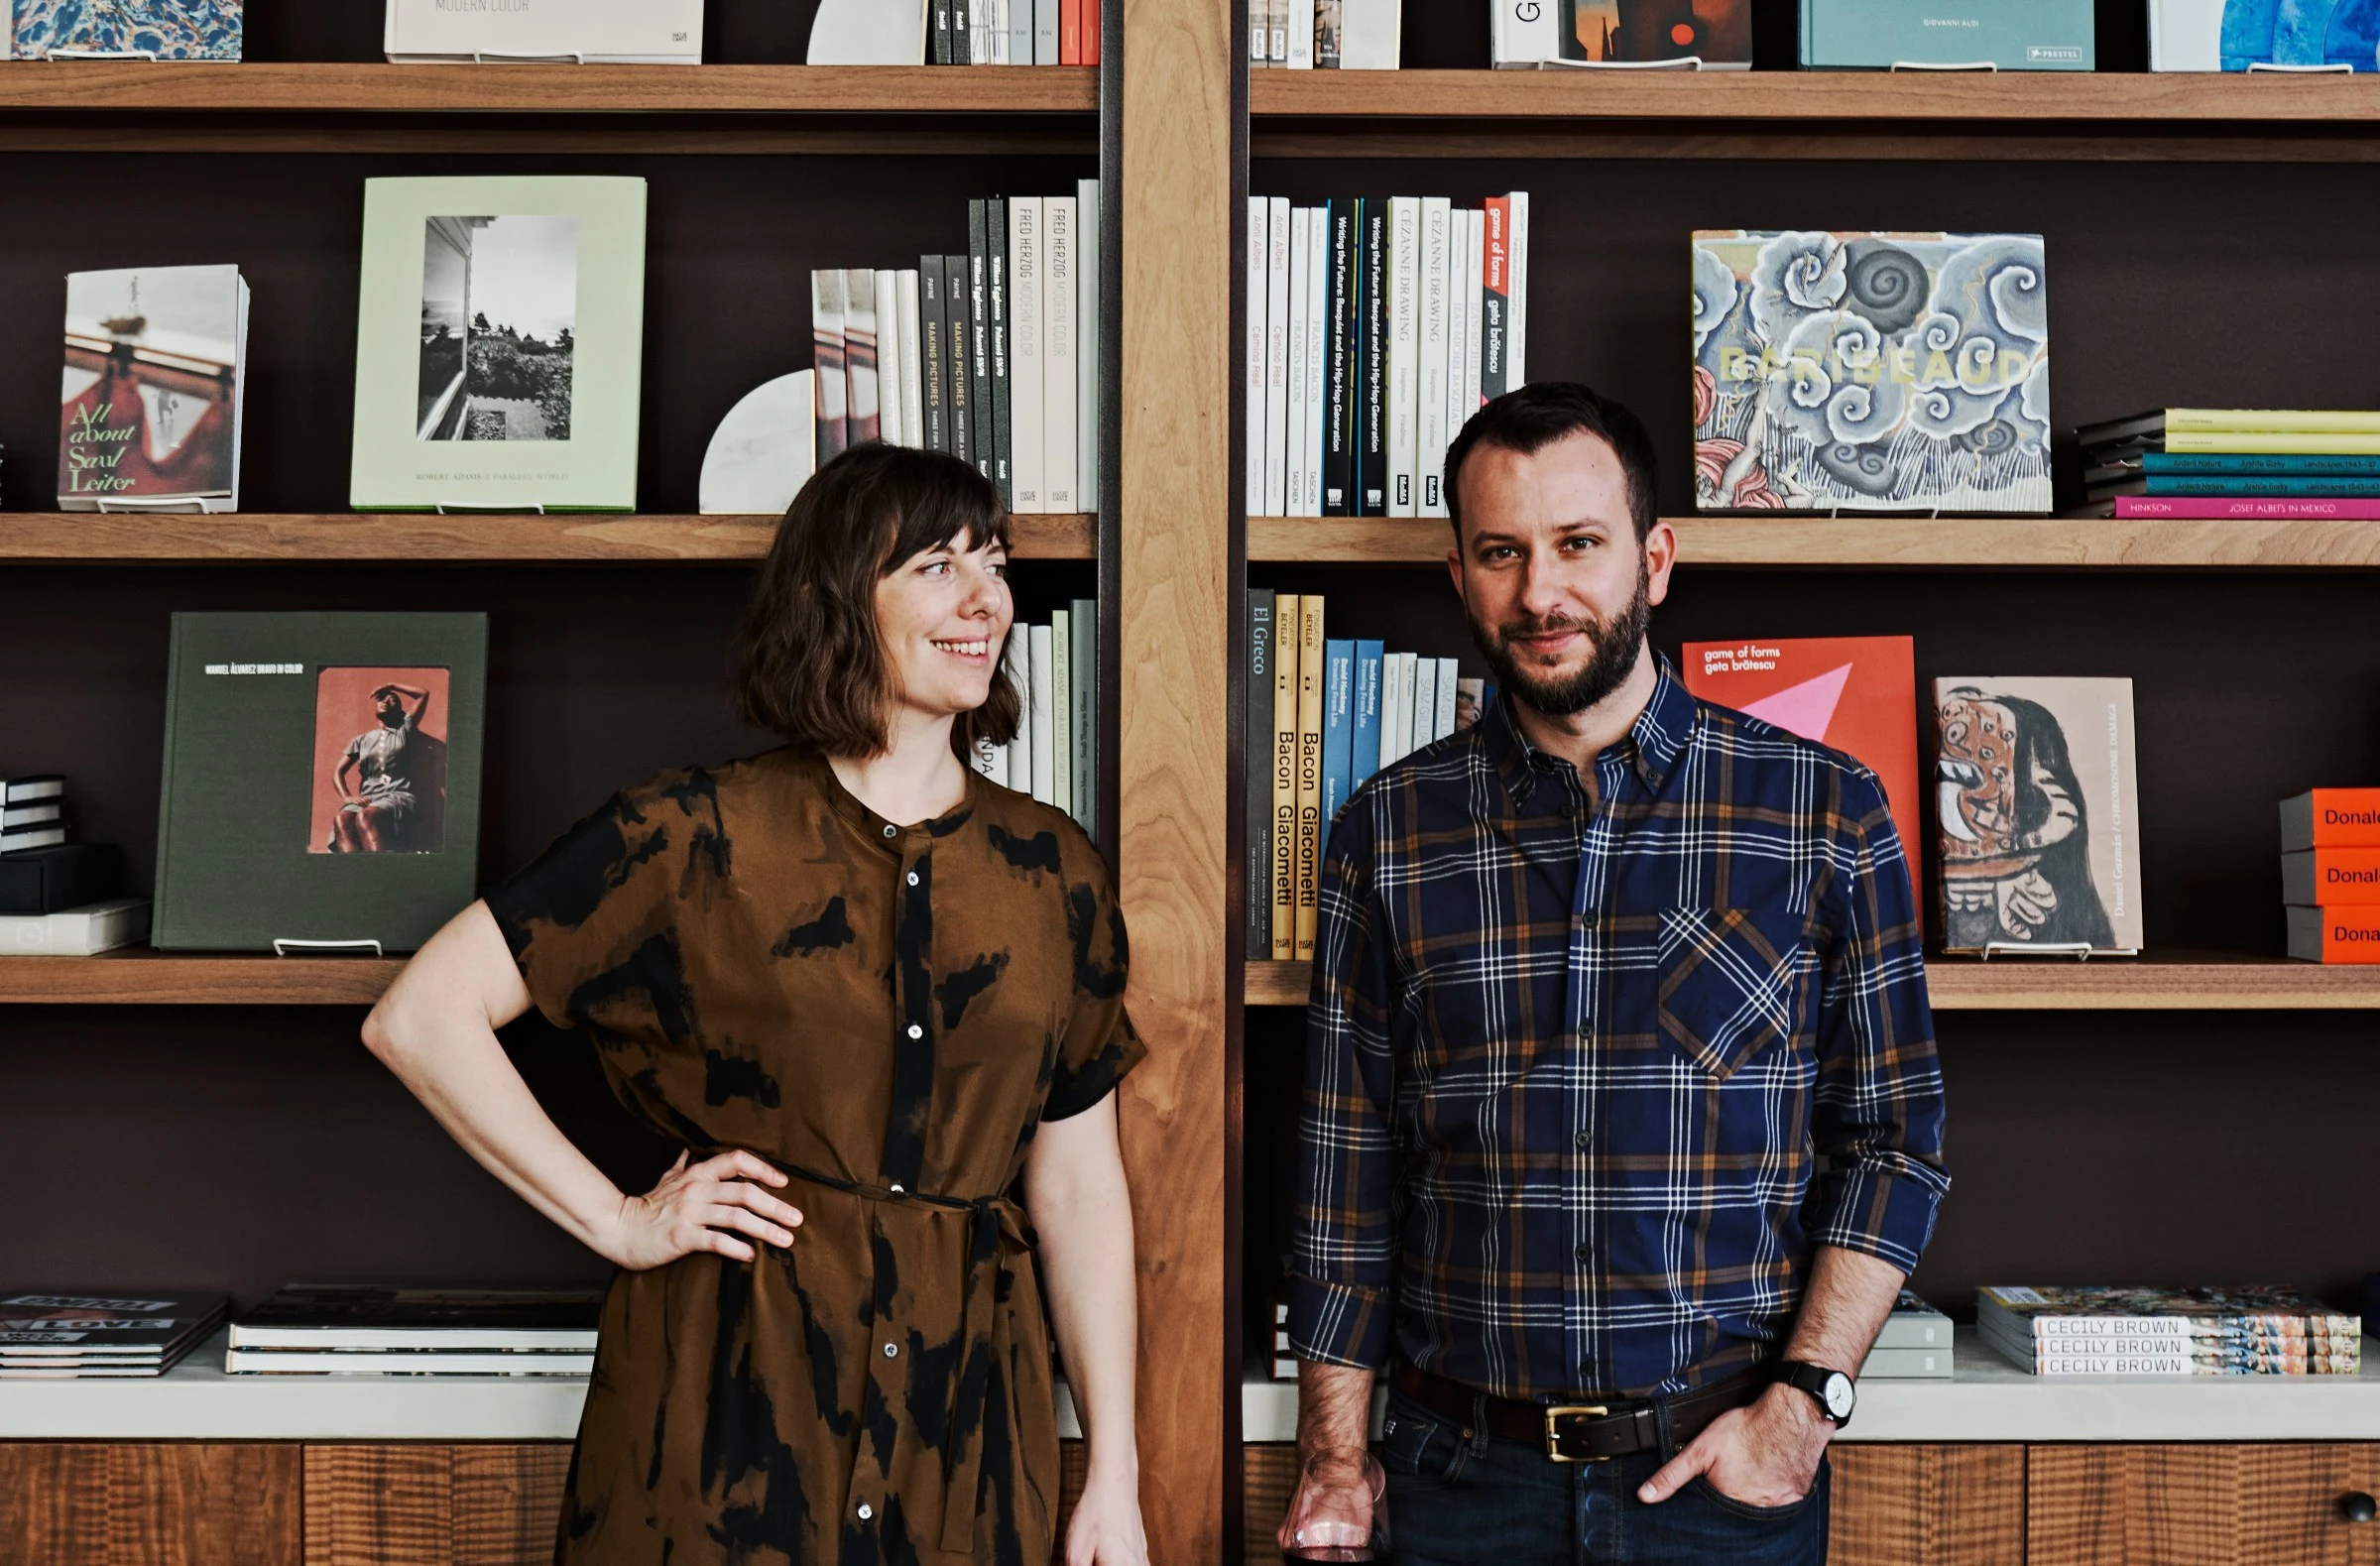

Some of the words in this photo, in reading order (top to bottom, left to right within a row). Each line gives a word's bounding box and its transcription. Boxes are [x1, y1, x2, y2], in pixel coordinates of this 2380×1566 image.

[1019, 208, 1032, 235] FRED
[1052, 208, 1066, 235] FRED
[1253, 214, 1262, 237] Anni
[1275, 214, 1284, 237] Anni
[1336, 216, 1346, 249] Writing
[1370, 216, 1379, 249] Writing
[1489, 207, 1500, 239] game
[1019, 237, 1032, 278] HERZOG
[1052, 237, 1066, 278] HERZOG
[1252, 240, 1262, 271] Albers
[1274, 240, 1284, 271] Albers
[1400, 208, 1413, 274] CÉZANNE
[1431, 209, 1443, 275] CÉZANNE
[1491, 241, 1502, 256] of
[1336, 265, 1345, 297] Future:
[1490, 256, 1502, 288] forms
[1019, 281, 1033, 322] MODERN
[1053, 281, 1066, 322] MODERN
[1399, 277, 1410, 341] DRAWING
[1429, 278, 1440, 342] DRAWING
[1488, 300, 1500, 325] geta
[927, 321, 937, 359] MAKING
[953, 321, 964, 359] MAKING
[1019, 324, 1033, 357] COLOR
[1053, 324, 1066, 357] COLOR
[1252, 325, 1261, 363] Camino
[1273, 325, 1282, 363] Camino
[1293, 319, 1303, 364] FRANCIS
[1311, 319, 1321, 365] FRANCIS
[928, 360, 939, 407] PICTURES
[954, 360, 965, 407] PICTURES
[1252, 365, 1261, 388] Real
[1272, 365, 1282, 388] Real
[1293, 366, 1302, 403] BACON
[1311, 366, 1320, 403] BACON
[1333, 368, 1342, 404] Hip-Hop
[1370, 368, 1379, 405] Hip-Hop
[70, 403, 113, 424] All
[69, 422, 136, 443] about
[68, 446, 126, 470] Saul
[69, 469, 136, 493] Leiter
[2130, 504, 2172, 513] HINKSON
[2229, 504, 2253, 513] JOSEF
[2257, 504, 2286, 513] ALBERS
[2289, 504, 2298, 513] IN
[2301, 504, 2336, 513] MEXICO
[1253, 607, 1269, 623] El
[1252, 627, 1269, 675] Greco
[1705, 650, 1734, 663] game
[1737, 646, 1748, 659] of
[1751, 645, 1780, 658] forms
[205, 664, 229, 674] MANUEL
[257, 663, 277, 674] BRAVO
[277, 663, 284, 674] IN
[1330, 657, 1341, 690] Drawing
[1340, 658, 1349, 680] David
[1359, 658, 1368, 691] Drawing
[1368, 659, 1377, 680] David
[1705, 662, 1728, 675] geta
[1338, 680, 1348, 715] Hockney
[1367, 681, 1376, 715] Hockney
[1420, 678, 1432, 703] SAM
[1442, 676, 1454, 702] SAM
[1419, 706, 1430, 744] GILLIA
[1441, 704, 1452, 737] GILLI
[2107, 701, 2118, 746] DAMAGE
[981, 739, 995, 775] NDA
[1278, 731, 1294, 789] Bacon
[1303, 732, 1319, 791] Bacon
[1277, 804, 1293, 906] Giacometti
[1300, 806, 1318, 907] Giacometti
[2327, 868, 2380, 883] Donal
[2112, 882, 2125, 917] Daniel
[2334, 926, 2380, 941] Dona
[2048, 1320, 2106, 1334] CECILY
[2114, 1320, 2179, 1334] BROWN
[2050, 1340, 2108, 1353] CECILY
[2117, 1340, 2181, 1353] BROWN
[2050, 1360, 2109, 1372] CECILY
[2117, 1360, 2181, 1372] BROWN
